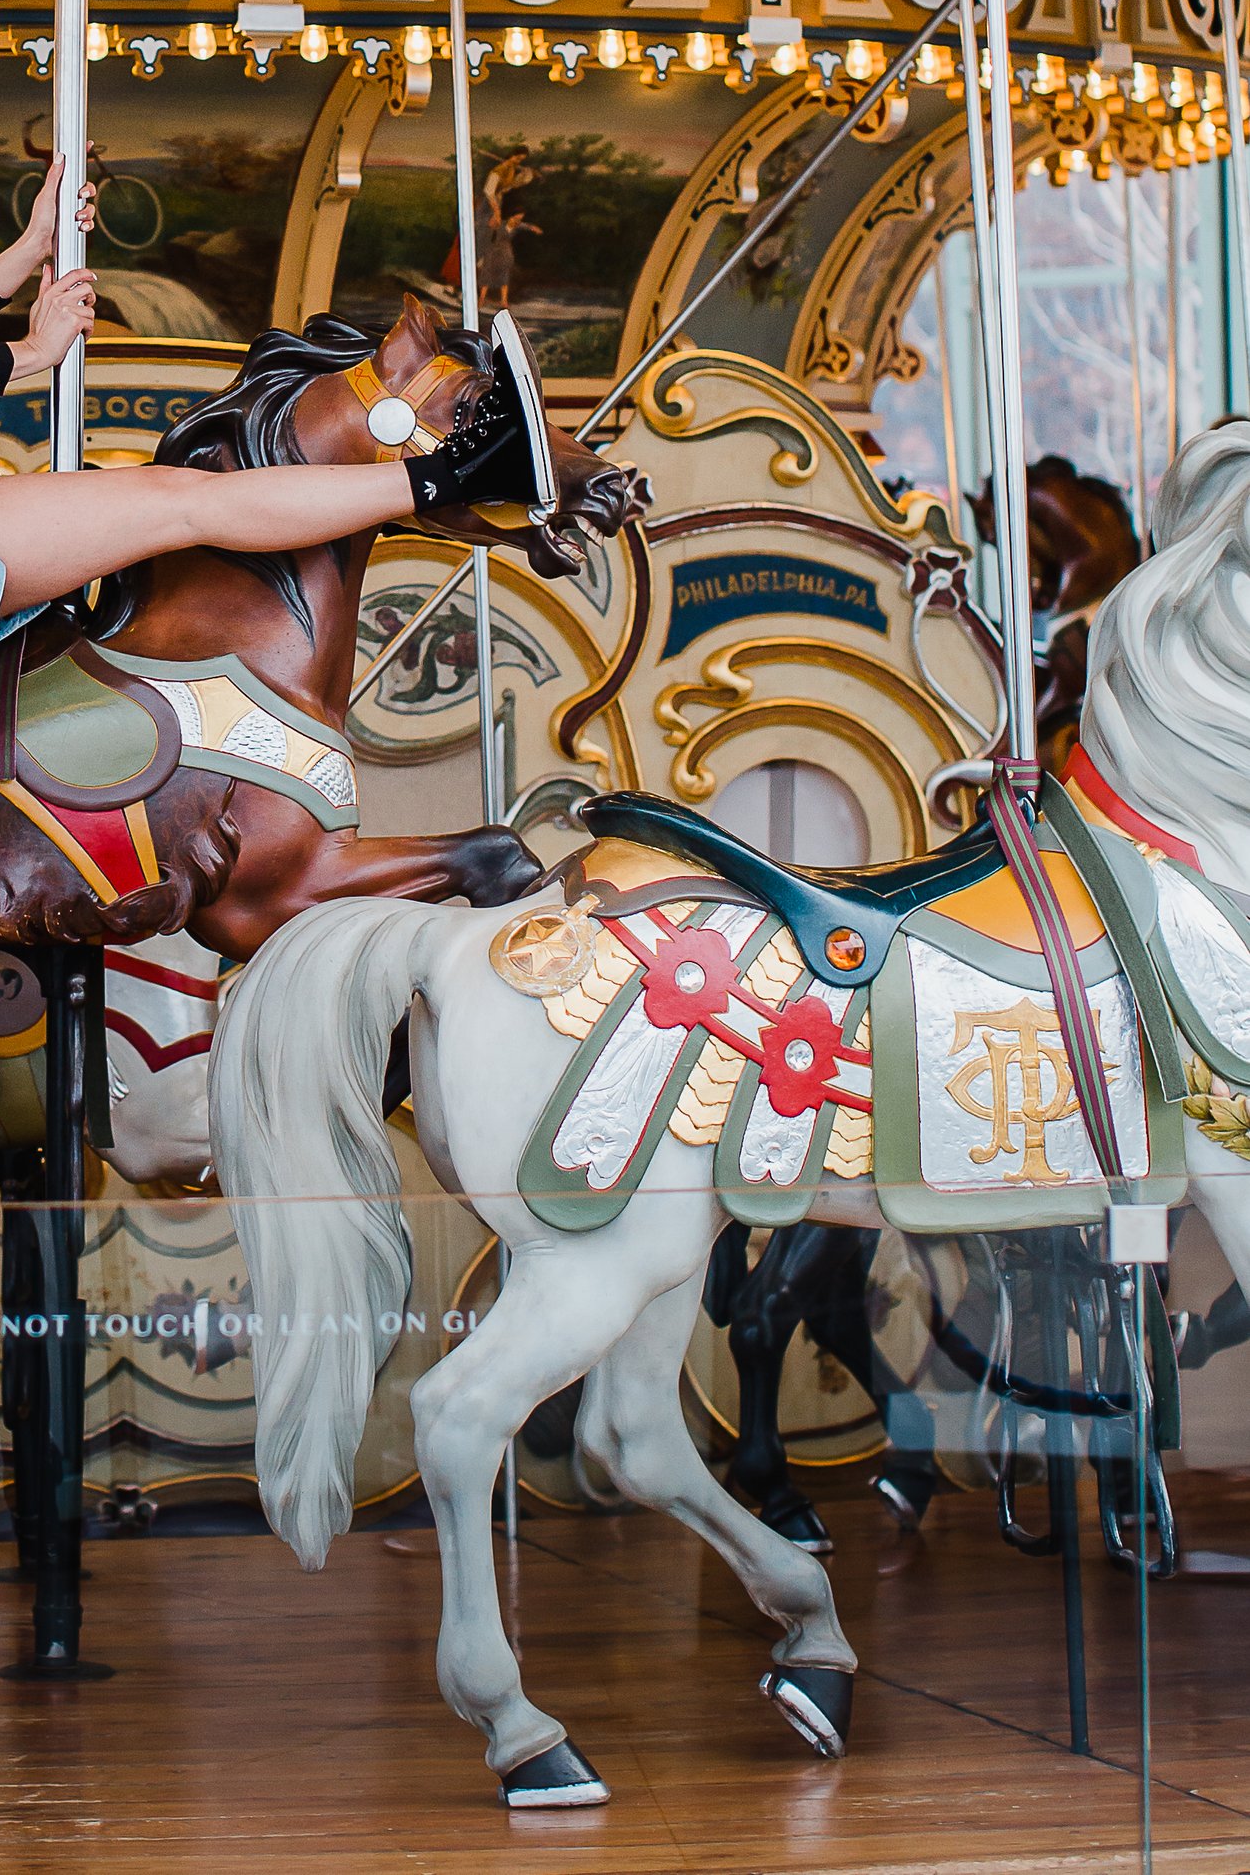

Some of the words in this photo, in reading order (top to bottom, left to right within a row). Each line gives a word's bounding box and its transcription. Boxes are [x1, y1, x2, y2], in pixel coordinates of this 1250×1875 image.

[26, 396, 191, 422] TBOGG
[1, 1313, 70, 1337] NOT
[84, 1313, 199, 1337] TOUCH
[218, 1312, 264, 1337] OR
[279, 1312, 363, 1336] LEAN
[379, 1311, 427, 1335] ON
